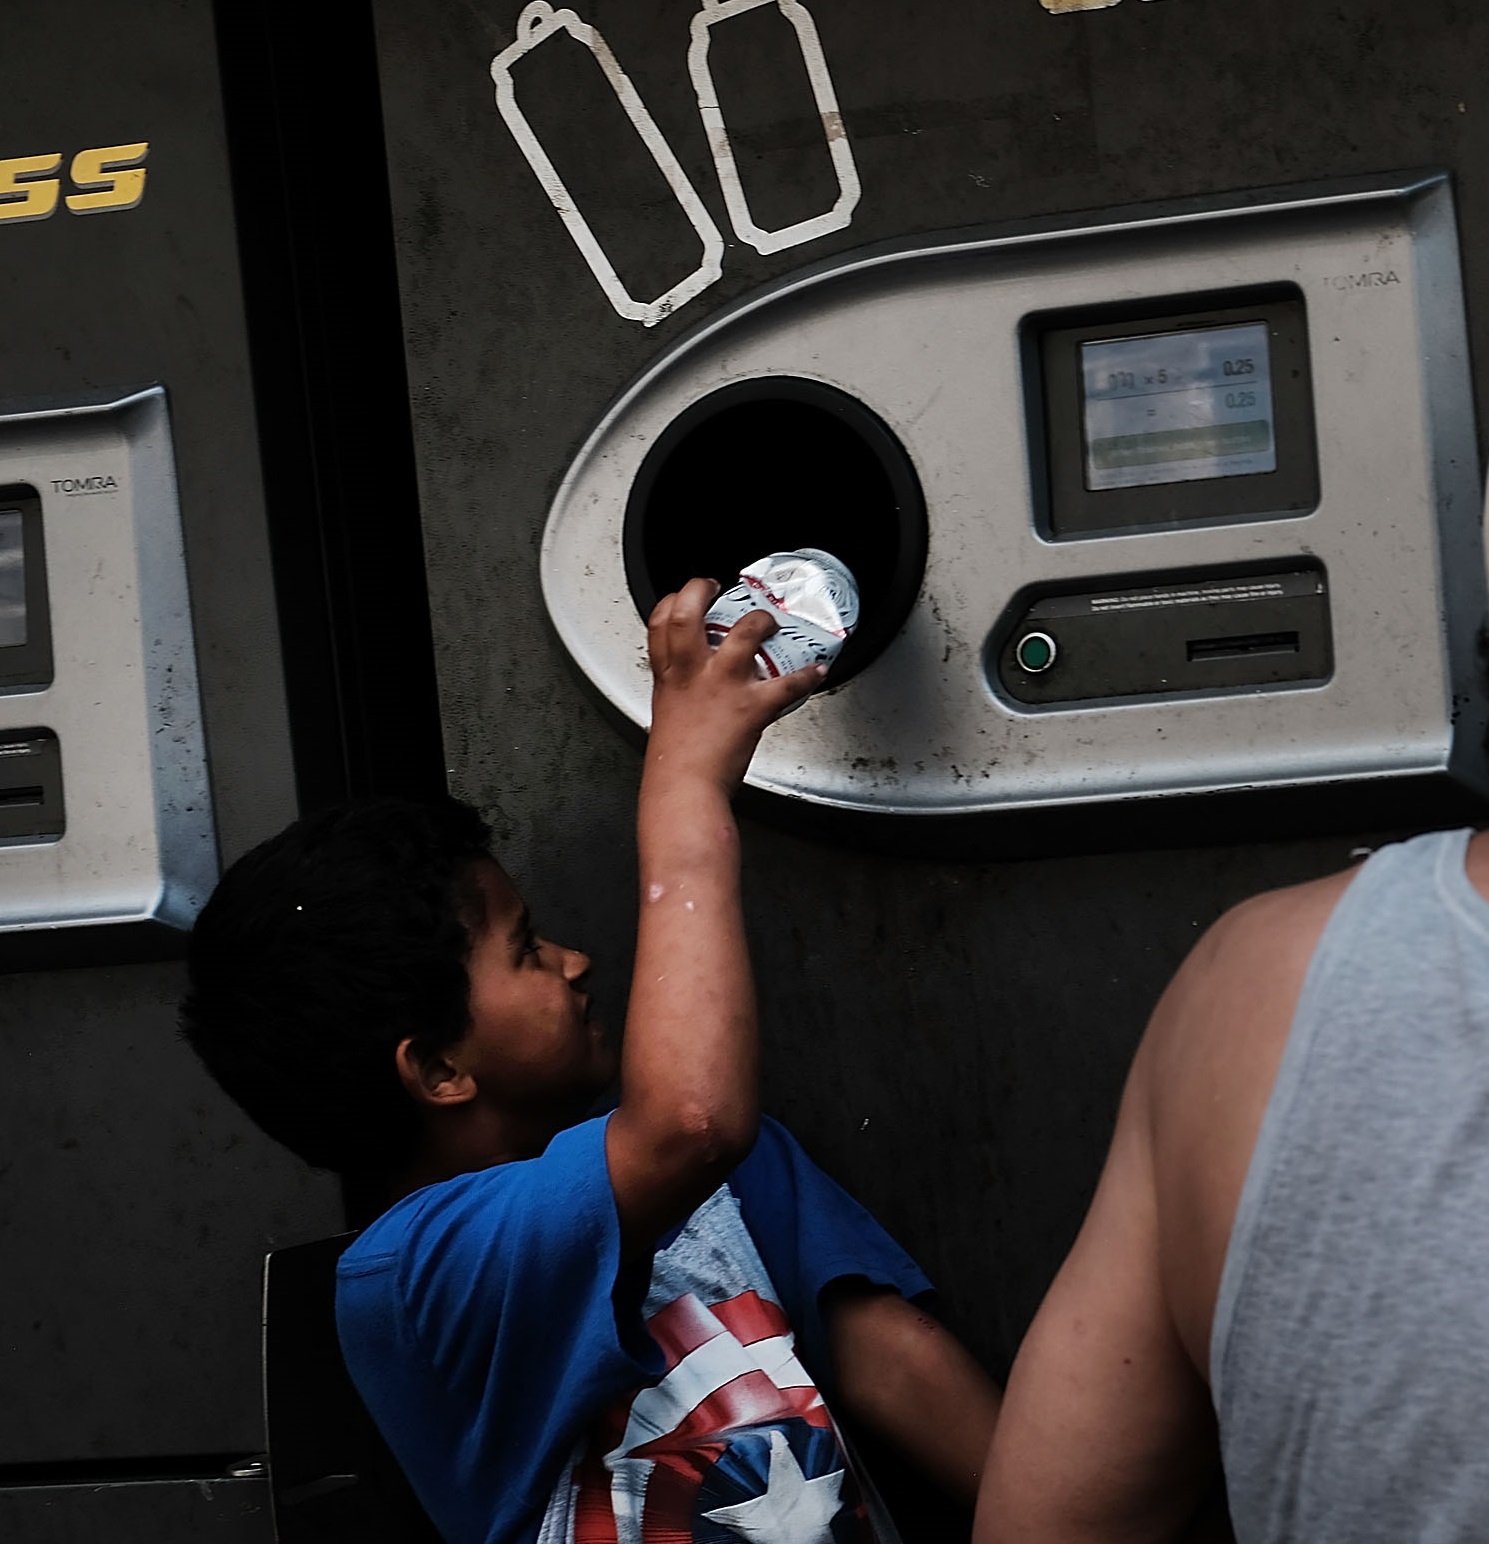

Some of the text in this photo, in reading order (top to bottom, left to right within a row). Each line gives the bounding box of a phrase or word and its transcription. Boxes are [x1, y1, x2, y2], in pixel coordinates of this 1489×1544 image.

[1157, 368, 1168, 385] 5
[1222, 358, 1256, 377] 0.25
[1224, 391, 1257, 409] 0.25
[50, 475, 118, 493] TOMRA
